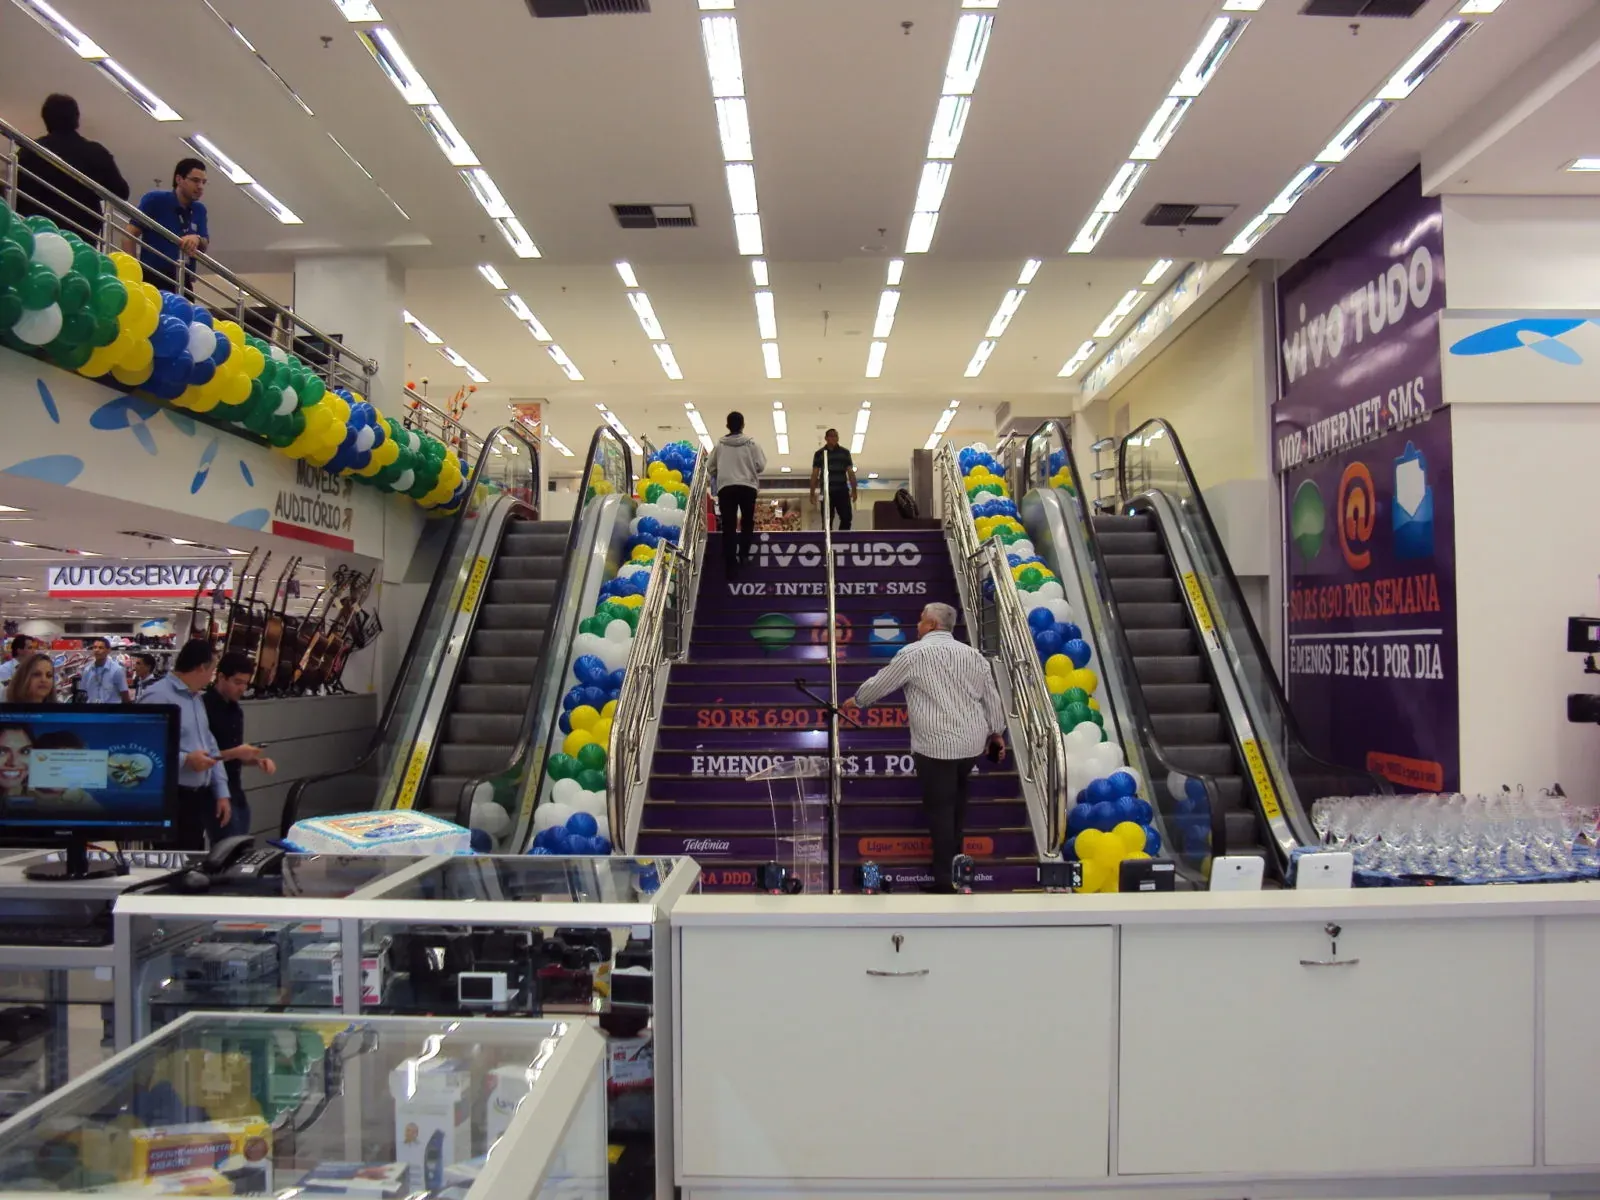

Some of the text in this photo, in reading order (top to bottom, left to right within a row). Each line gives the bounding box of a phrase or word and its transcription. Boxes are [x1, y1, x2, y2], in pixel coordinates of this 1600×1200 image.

[1283, 246, 1433, 383] vivo TUDO
[1279, 376, 1426, 470] VOZ INTERNET SMS
[275, 493, 341, 531] AUDITÓRIO
[832, 543, 921, 567] TUDO
[728, 583, 766, 596] VOZ
[886, 582, 927, 595] SMS
[1344, 582, 1372, 617] POR
[1374, 573, 1441, 616] SEMANA
[1296, 644, 1332, 675] MENOS
[1334, 644, 1350, 676] DE
[1352, 642, 1370, 680] R$
[1371, 645, 1379, 677] 1
[1383, 643, 1411, 678] POR
[1414, 643, 1443, 679] DIA
[729, 708, 759, 728] R$
[707, 755, 785, 774] MENOS
[864, 755, 876, 774] 1
[885, 755, 917, 775] PO
[683, 838, 730, 851] Telefônica
[895, 874, 935, 882] Conectados
